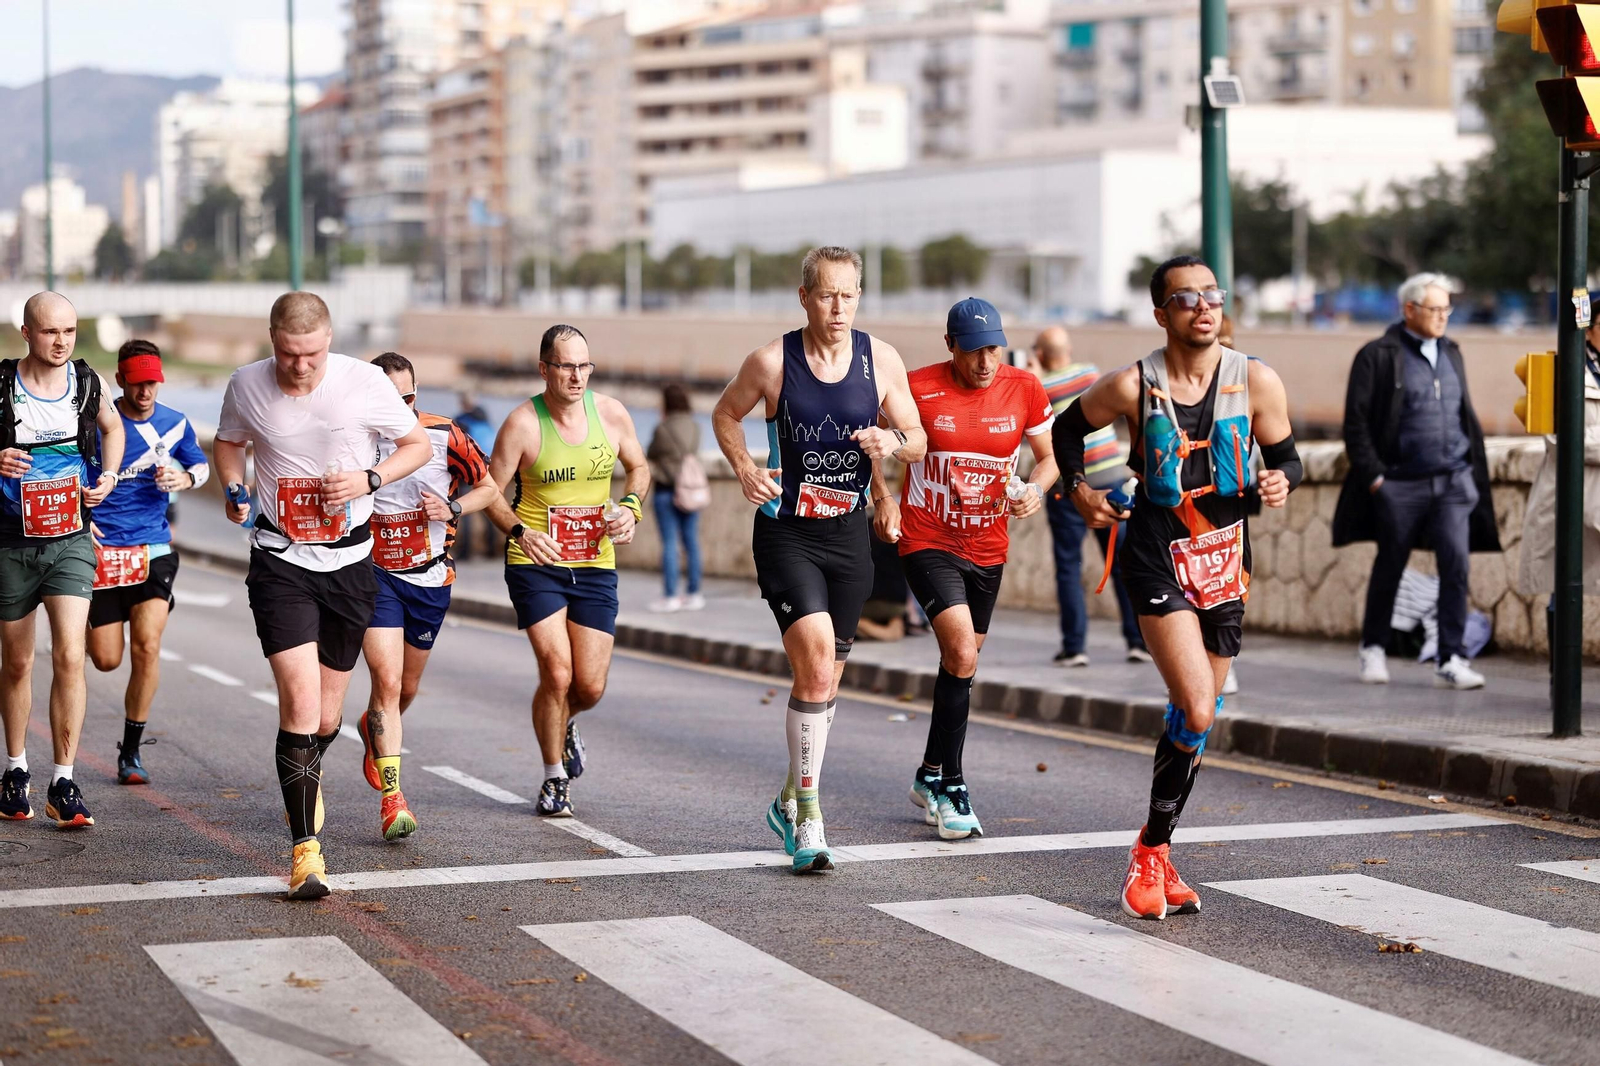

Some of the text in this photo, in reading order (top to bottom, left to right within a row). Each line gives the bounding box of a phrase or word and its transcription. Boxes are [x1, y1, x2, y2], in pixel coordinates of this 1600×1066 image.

[966, 459, 1005, 471] GENERALI
[541, 467, 576, 484] JAMIE
[804, 470, 857, 483] OxfordTri
[963, 472, 996, 485] 7207
[38, 478, 73, 491] GENERALI
[295, 479, 322, 489] GENE
[37, 492, 67, 507] 7196
[293, 493, 320, 506] 471
[818, 489, 853, 503] GENERA
[379, 511, 419, 524] GENERALI
[565, 507, 600, 516] GENERALI
[564, 519, 593, 531] 7046
[380, 526, 411, 540] 6343
[1190, 528, 1237, 550] GENERALI
[103, 550, 132, 561] 5537
[1191, 547, 1231, 570] 7167
